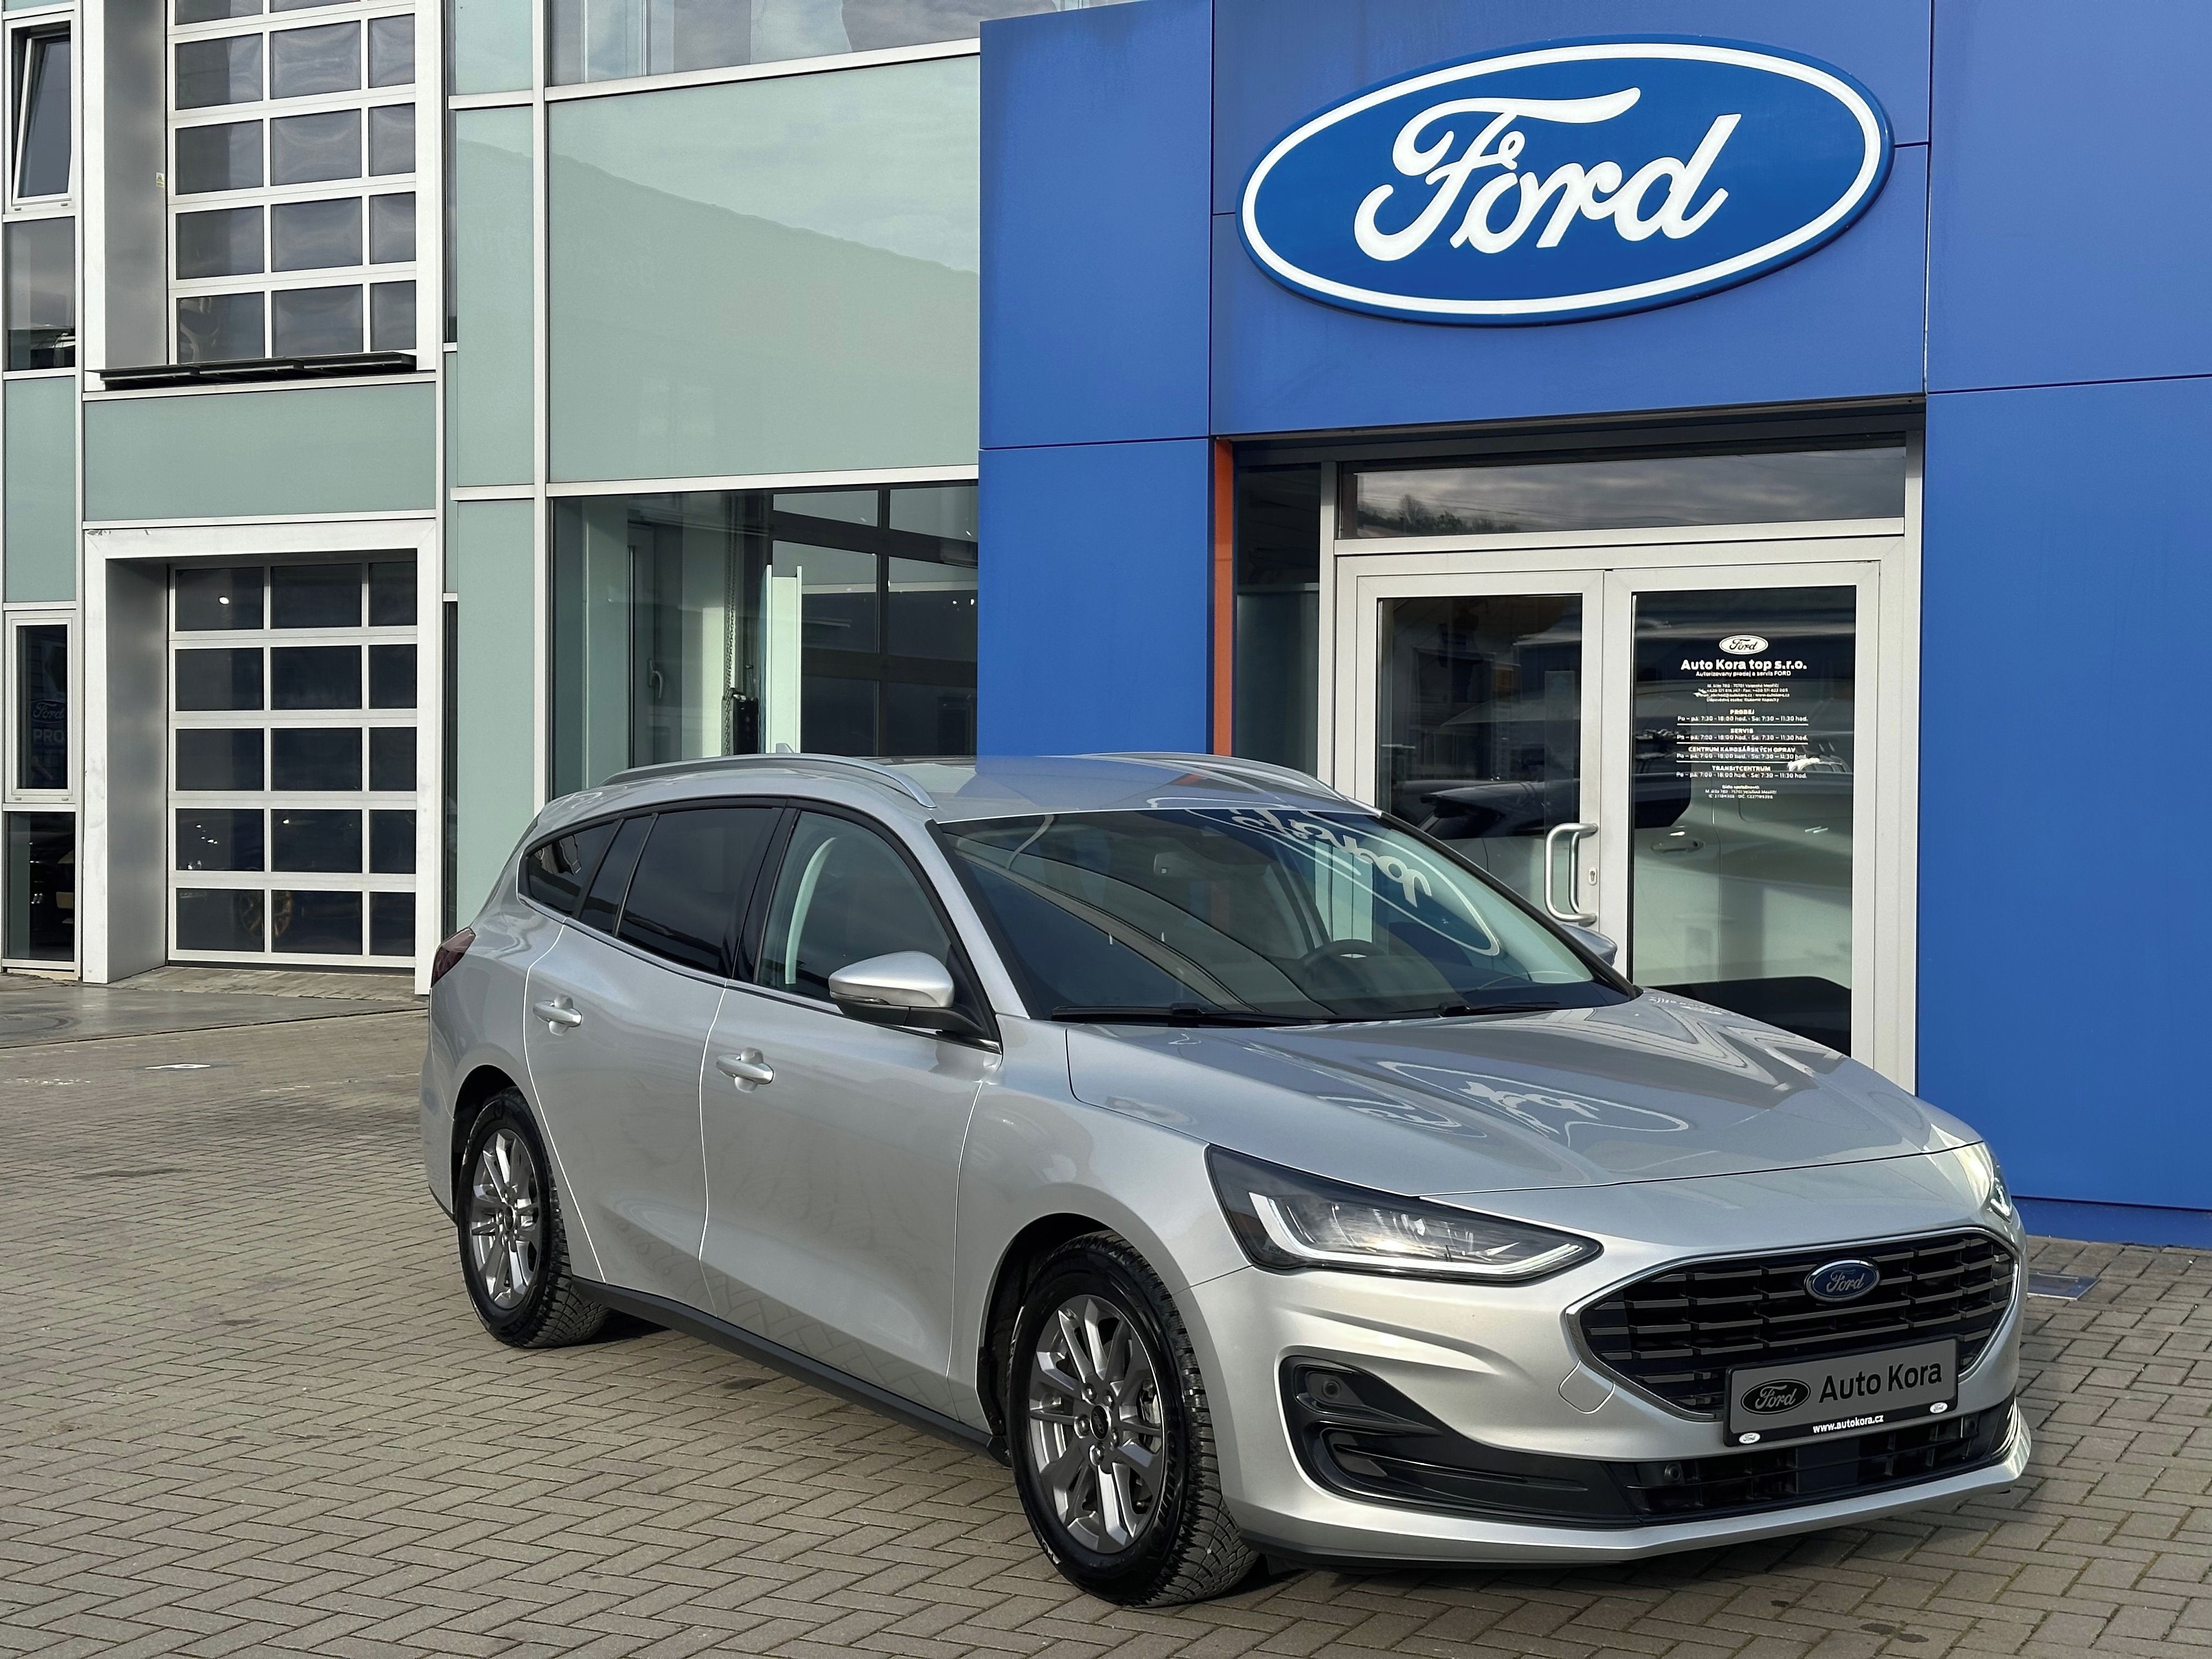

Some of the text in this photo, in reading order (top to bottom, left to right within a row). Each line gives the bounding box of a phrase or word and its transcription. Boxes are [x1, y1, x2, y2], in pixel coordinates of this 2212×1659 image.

[1353, 86, 1743, 262] Ford
[1729, 638, 1758, 651] Ford
[1680, 659, 1807, 672] Auto Kora top s.r.o.
[32, 701, 65, 720] Ford
[32, 729, 65, 743] PRO
[1825, 1268, 1866, 1293] Ford
[1754, 1361, 1942, 1410] Ford Auto Kora
[1812, 1414, 1884, 1434] www.autokora.cz
